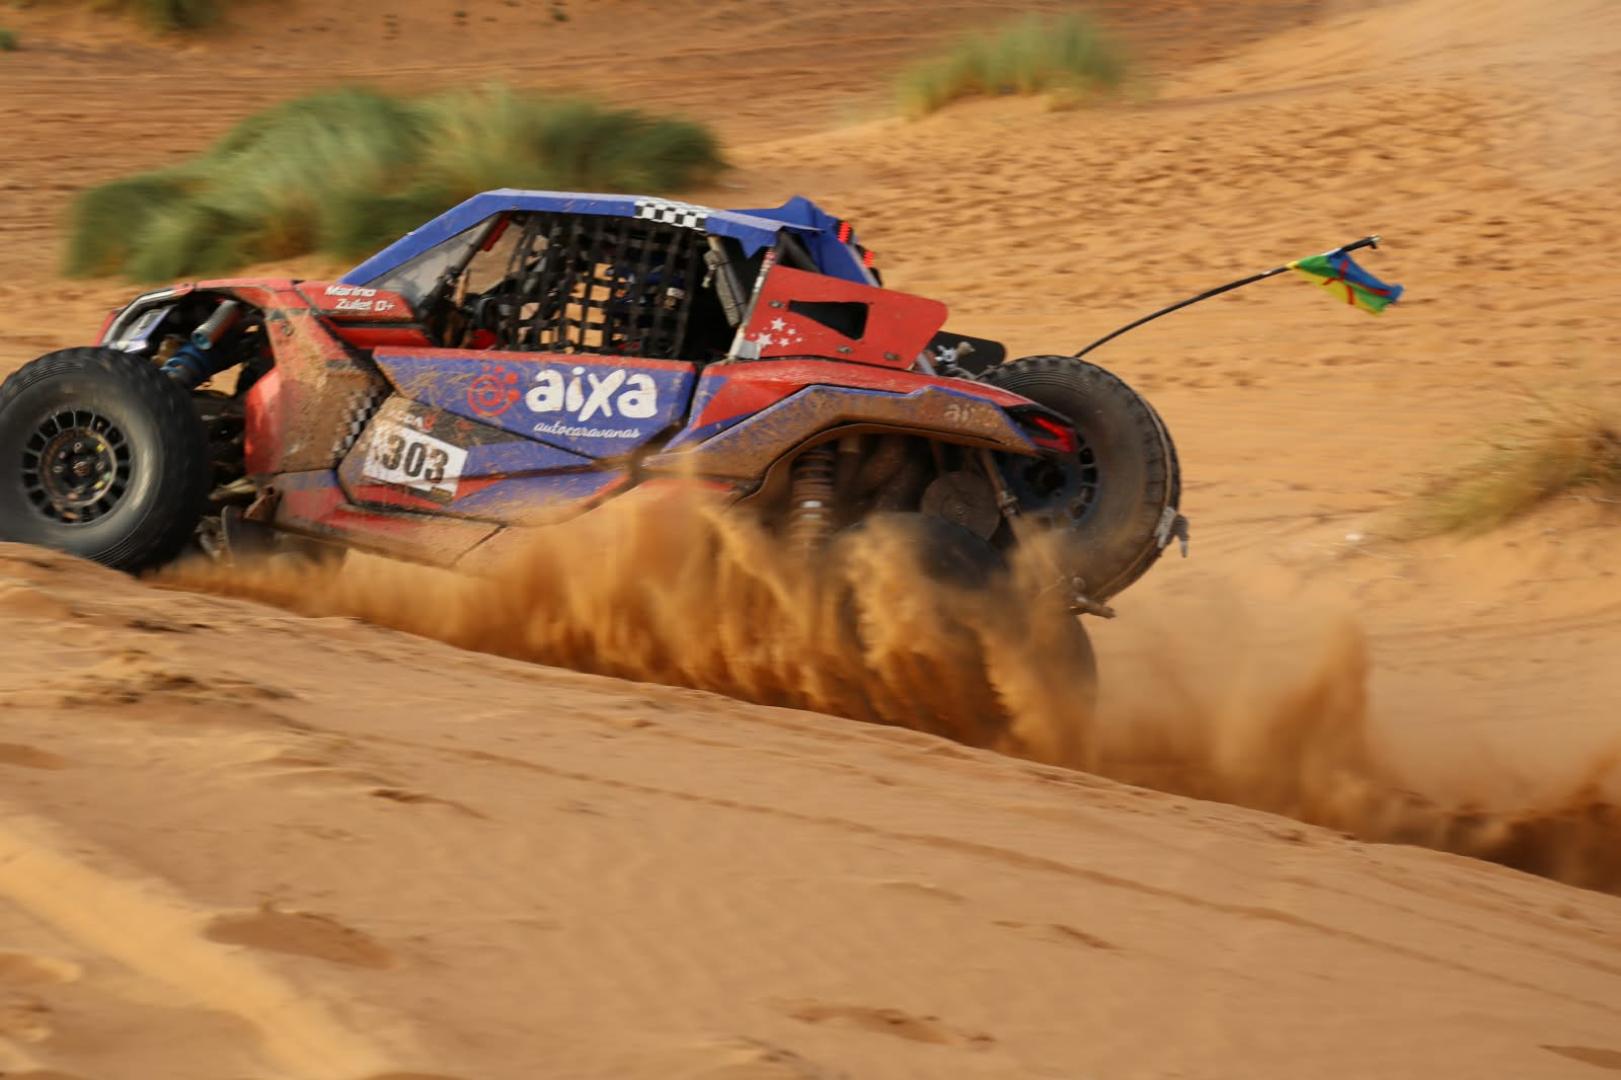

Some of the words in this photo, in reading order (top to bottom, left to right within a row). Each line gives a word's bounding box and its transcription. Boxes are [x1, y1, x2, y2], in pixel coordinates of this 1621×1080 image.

[525, 367, 658, 422] aixa
[533, 420, 641, 439] autocaravanas
[382, 435, 449, 484] 303
